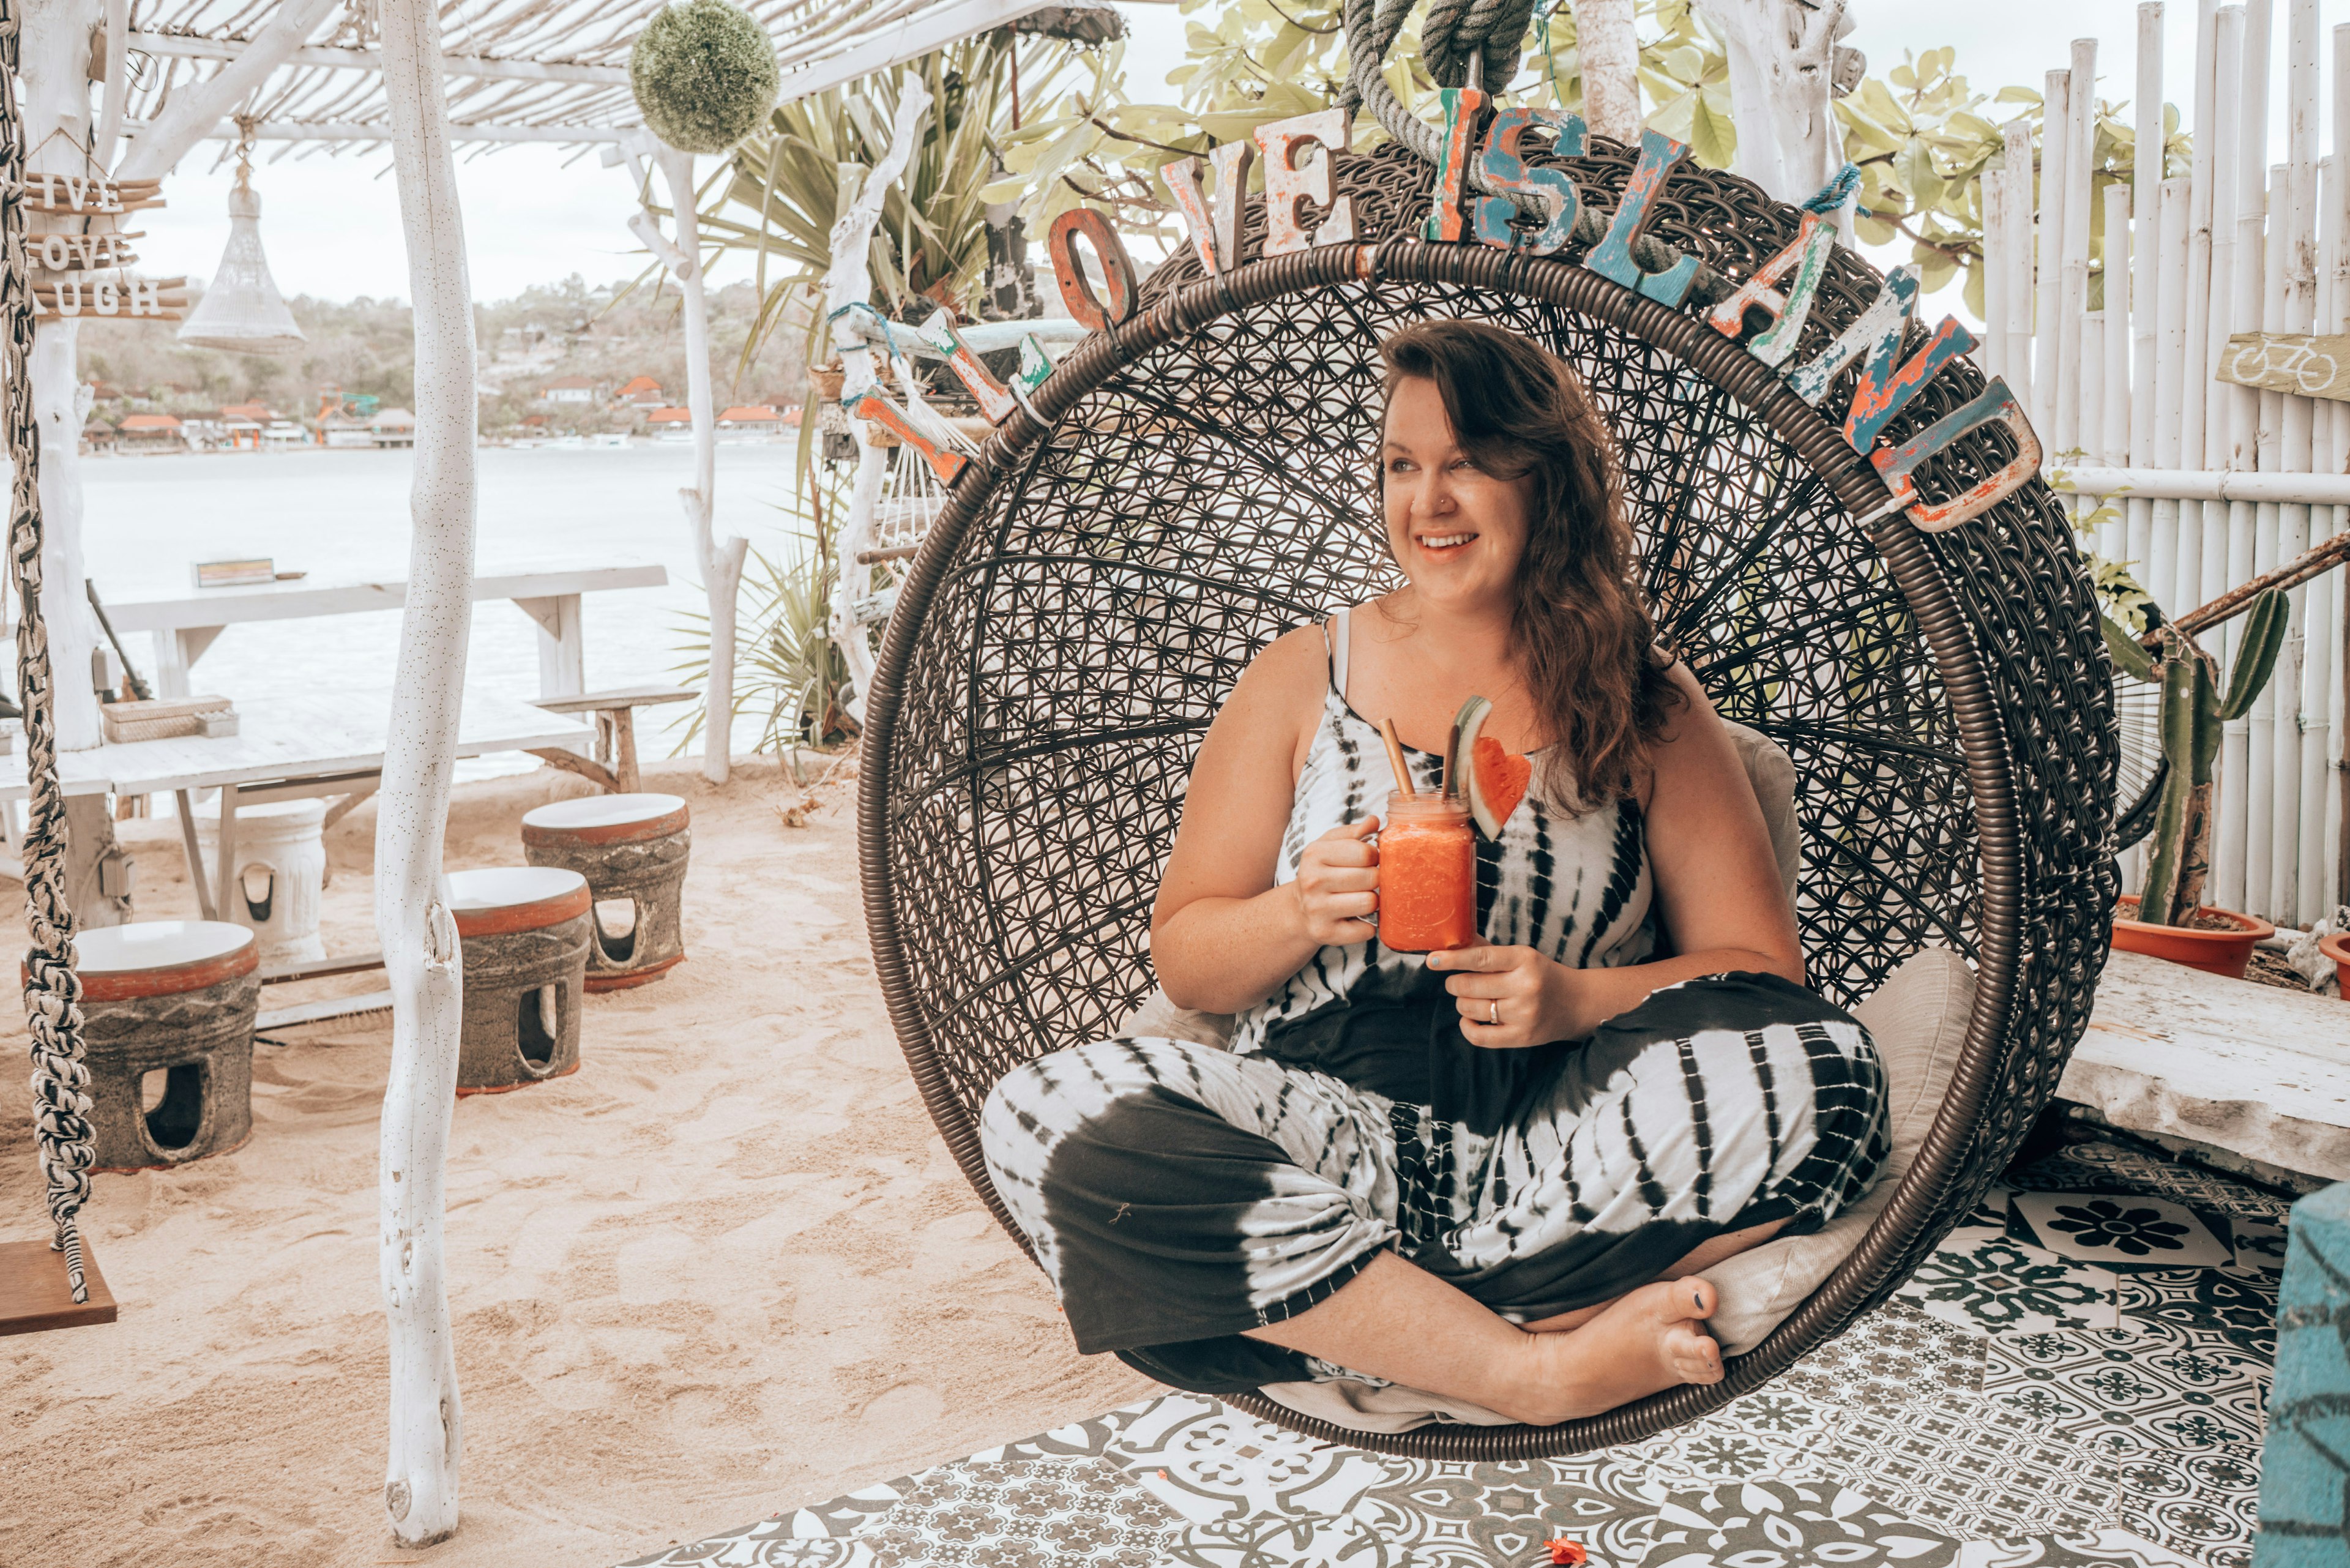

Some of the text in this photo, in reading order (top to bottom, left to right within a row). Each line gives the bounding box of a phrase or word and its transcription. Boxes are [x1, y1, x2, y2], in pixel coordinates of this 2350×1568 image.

[23, 174, 124, 212] IVE
[28, 234, 128, 271] OVE
[31, 280, 162, 316] UGH
[917, 107, 1360, 426] LOVE
[1426, 88, 2044, 533] ISLAND
